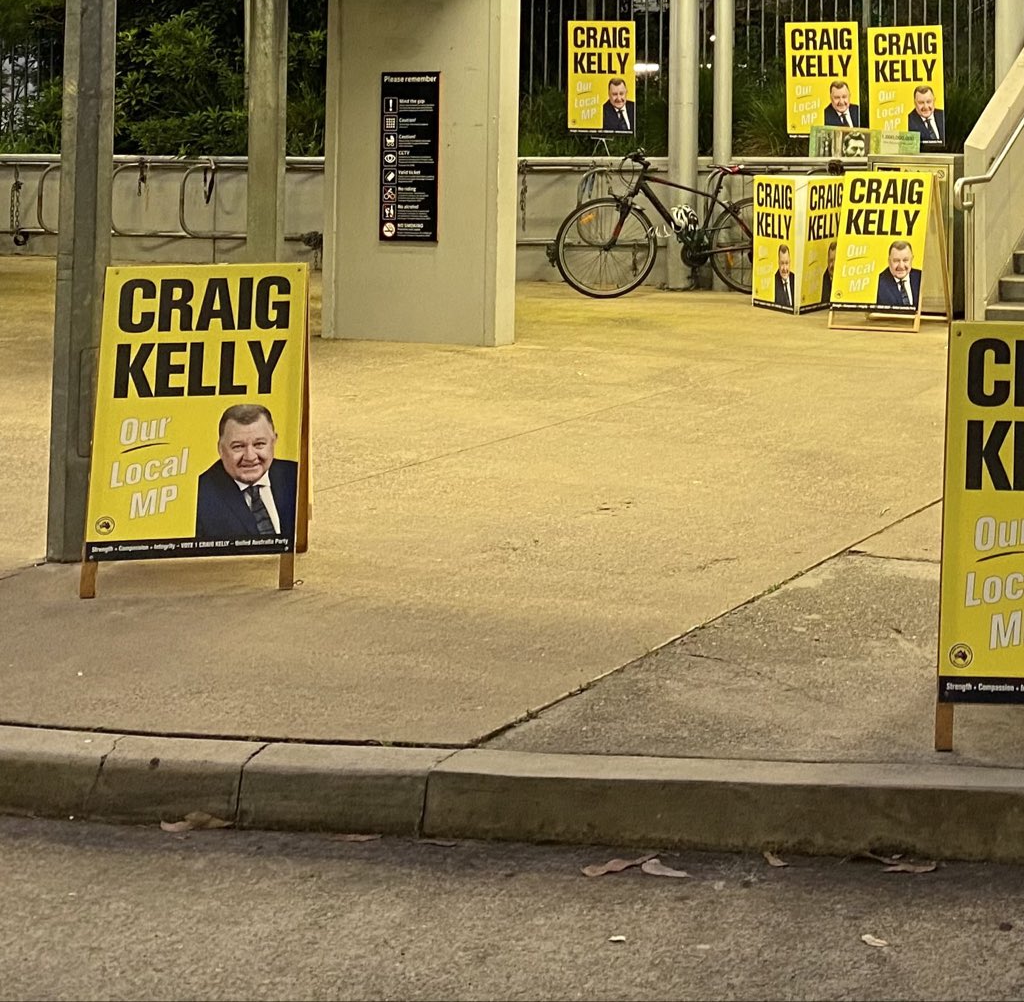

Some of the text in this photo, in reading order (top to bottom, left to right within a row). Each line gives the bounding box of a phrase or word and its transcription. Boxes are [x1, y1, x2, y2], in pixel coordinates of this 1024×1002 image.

[573, 26, 630, 49] CRAIG
[791, 28, 852, 51] CRAIG
[873, 32, 937, 56] CRAIG
[573, 52, 629, 75] KELLY
[792, 54, 852, 77] KELLY
[874, 59, 936, 83] KELLY
[384, 75, 437, 83] Please remember
[795, 85, 812, 96] Our
[793, 97, 820, 113] Local
[878, 90, 896, 102] Our
[801, 113, 818, 125] MP
[876, 104, 904, 119] Local
[756, 182, 793, 211] CRAIG
[809, 182, 844, 211] CRAIG
[849, 178, 924, 205] CRAIG
[756, 212, 792, 240] KELLY
[845, 209, 921, 236] KELLY
[846, 244, 869, 258] Our
[842, 260, 875, 278] Local
[848, 277, 870, 293] MP
[118, 275, 291, 334] CRAIG
[113, 339, 287, 398] KELLY
[119, 415, 171, 446] Our
[110, 448, 190, 488] Local
[129, 485, 178, 520] MP
[946, 682, 972, 693] Strength
[978, 683, 1015, 693] Compassion
